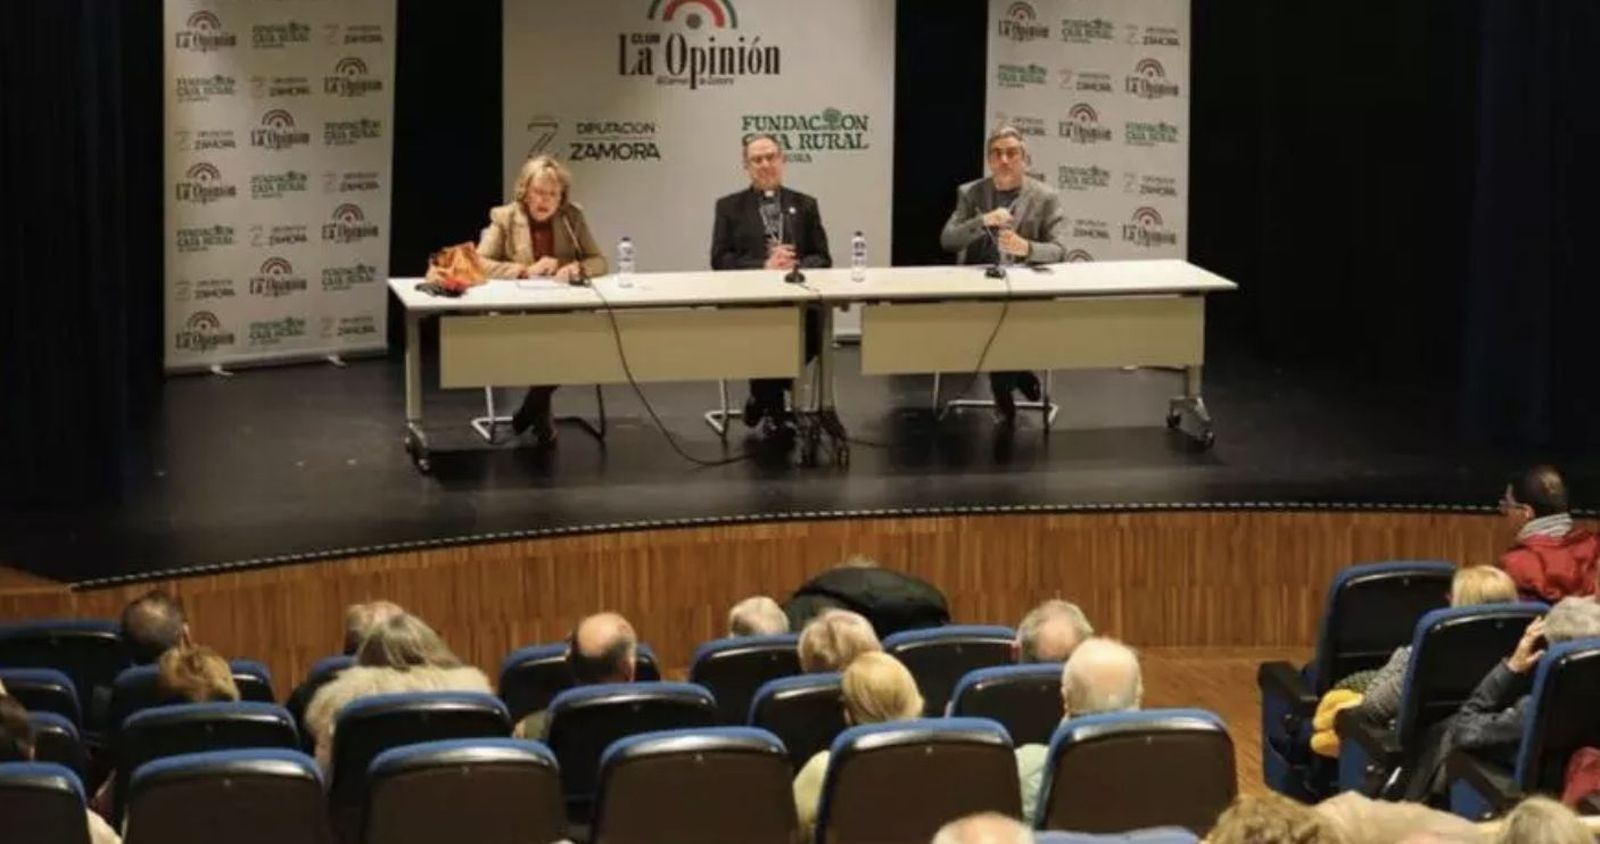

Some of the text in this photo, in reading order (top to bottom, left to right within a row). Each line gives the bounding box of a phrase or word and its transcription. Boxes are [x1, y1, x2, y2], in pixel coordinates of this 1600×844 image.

[618, 33, 780, 90] La Opinión
[799, 133, 869, 150] RURAL
[569, 142, 661, 161] ZAMORA
